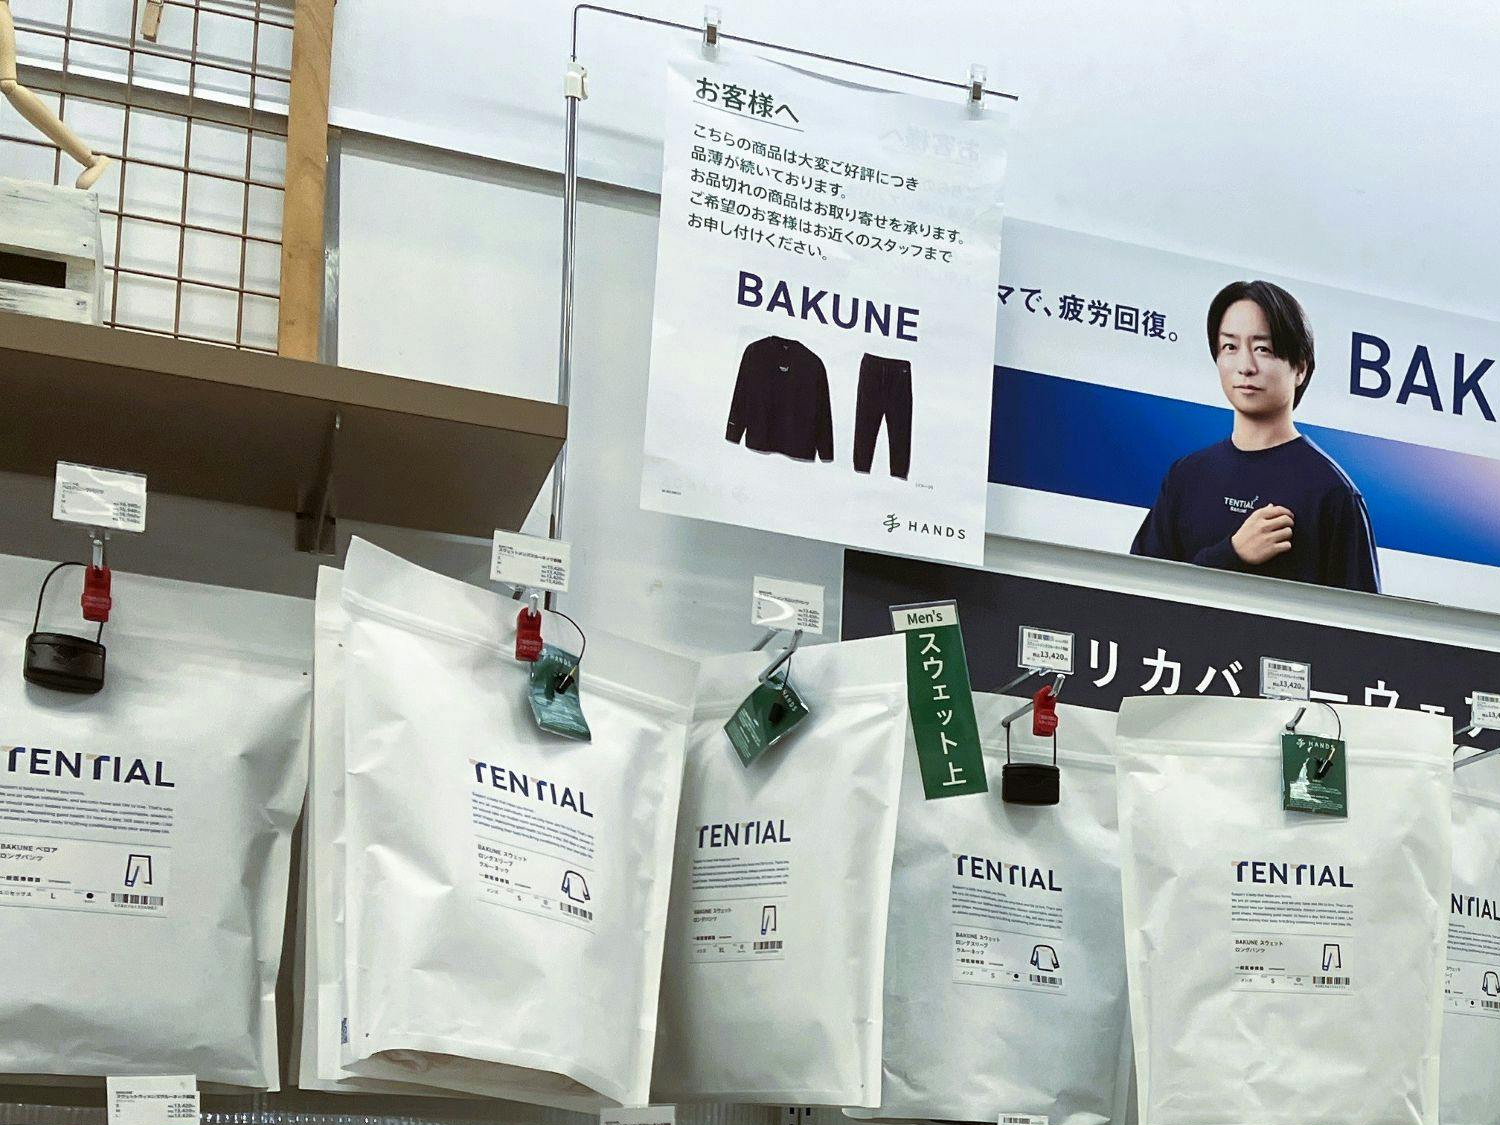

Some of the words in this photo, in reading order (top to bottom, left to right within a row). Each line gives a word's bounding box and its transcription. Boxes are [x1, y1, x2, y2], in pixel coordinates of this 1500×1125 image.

[695, 76, 800, 123] お客様へ
[691, 145, 846, 200] 品薄が続いております。
[694, 123, 919, 192] こちらの商品は大変ご好評につき
[689, 190, 953, 263] ご希望のお客様はお近くのスタッフまで
[690, 168, 966, 246] お品切れの商品はお取り寄せを承ります。
[687, 212, 829, 261] お申し付けください。
[737, 270, 920, 342] BAKUNE
[908, 520, 967, 540] HANDS
[907, 609, 943, 626] Men's
[918, 632, 967, 788] スウェット上
[2, 745, 175, 788] TENTIAL
[469, 758, 593, 818] TENTIAL
[696, 819, 791, 849] TENTIAL
[952, 853, 1062, 892] TENTIAL
[1231, 860, 1354, 888] TENTIAL
